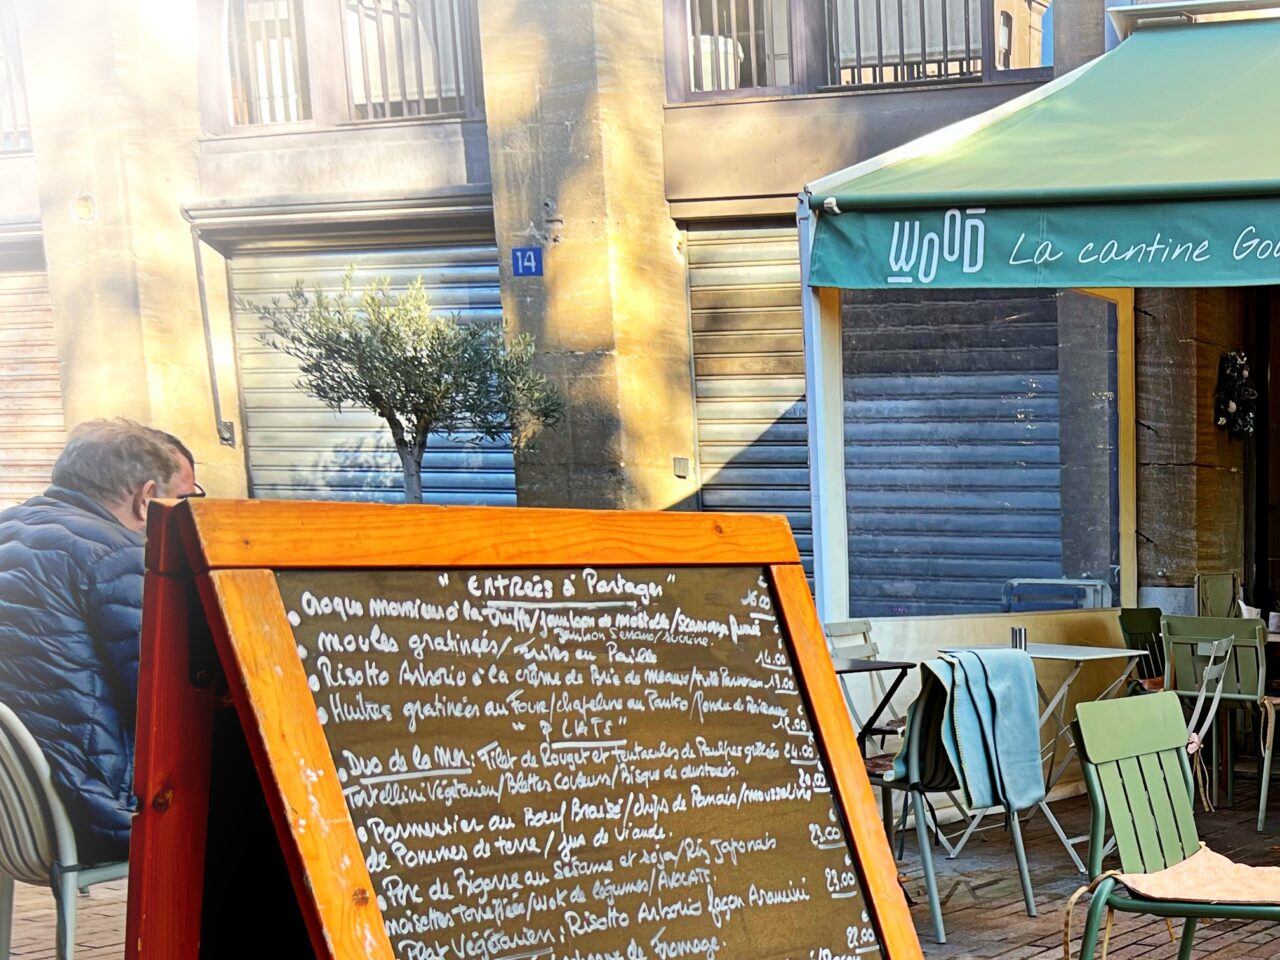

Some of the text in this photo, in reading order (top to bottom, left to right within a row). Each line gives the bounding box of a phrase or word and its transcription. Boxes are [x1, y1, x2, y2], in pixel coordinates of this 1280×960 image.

[516, 251, 536, 273] 14
[888, 208, 986, 284] WOOD
[1009, 232, 1062, 266] La
[1077, 239, 1211, 264] cantine
